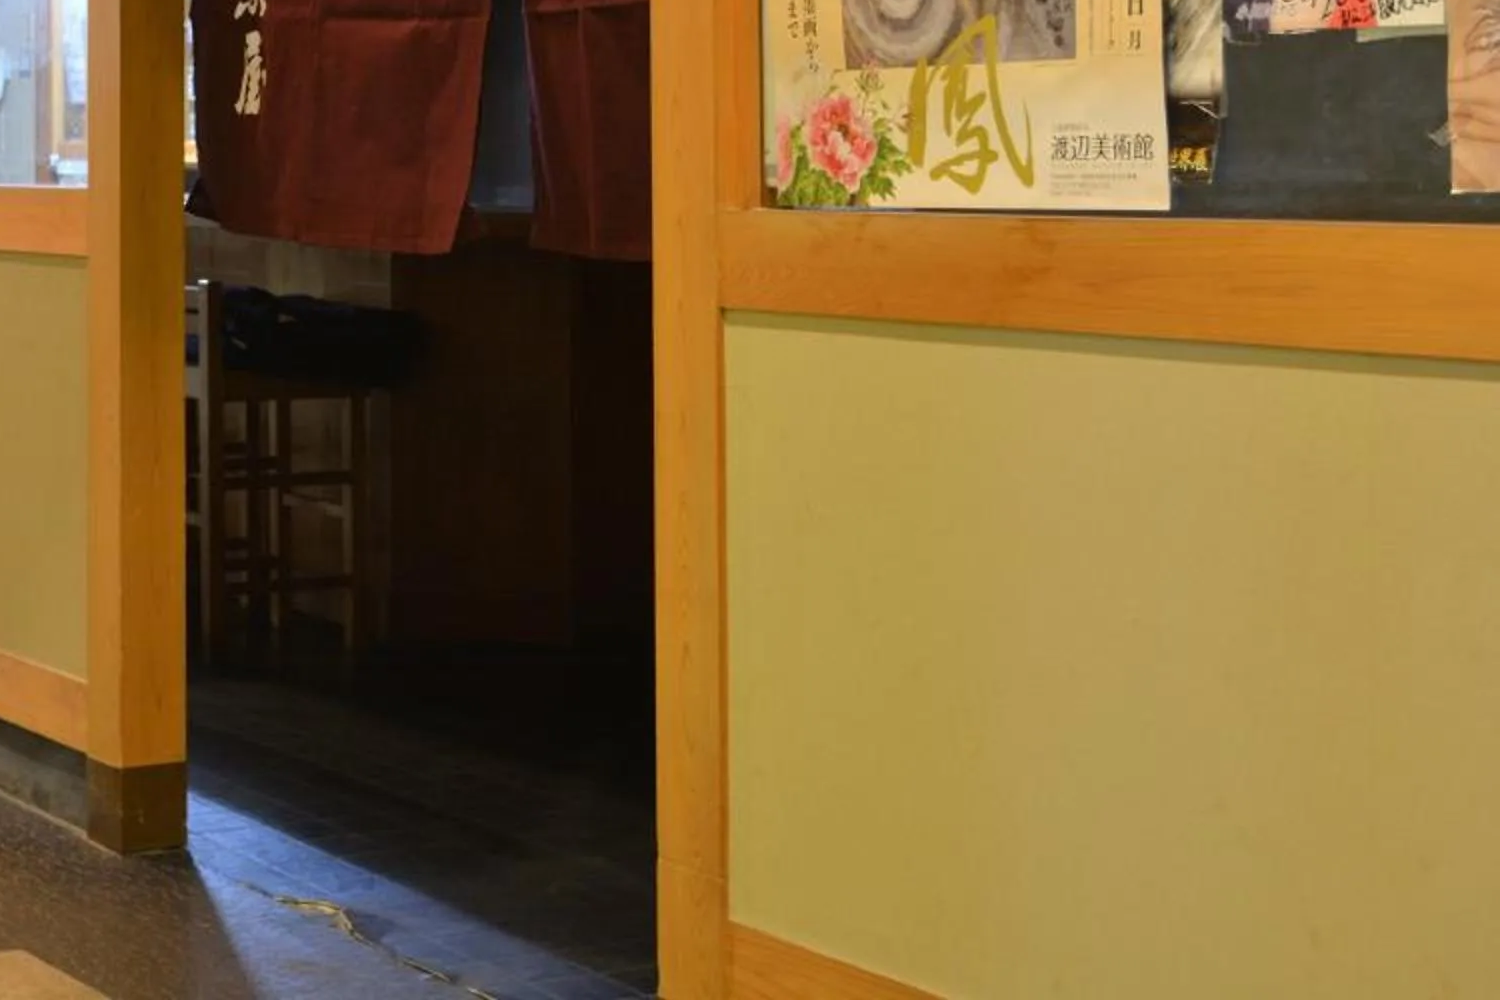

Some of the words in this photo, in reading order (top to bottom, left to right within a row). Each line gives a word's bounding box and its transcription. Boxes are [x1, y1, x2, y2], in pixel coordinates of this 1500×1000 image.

[908, 14, 1034, 195] 鳳
[1051, 133, 1155, 162] 渡辺美術館
